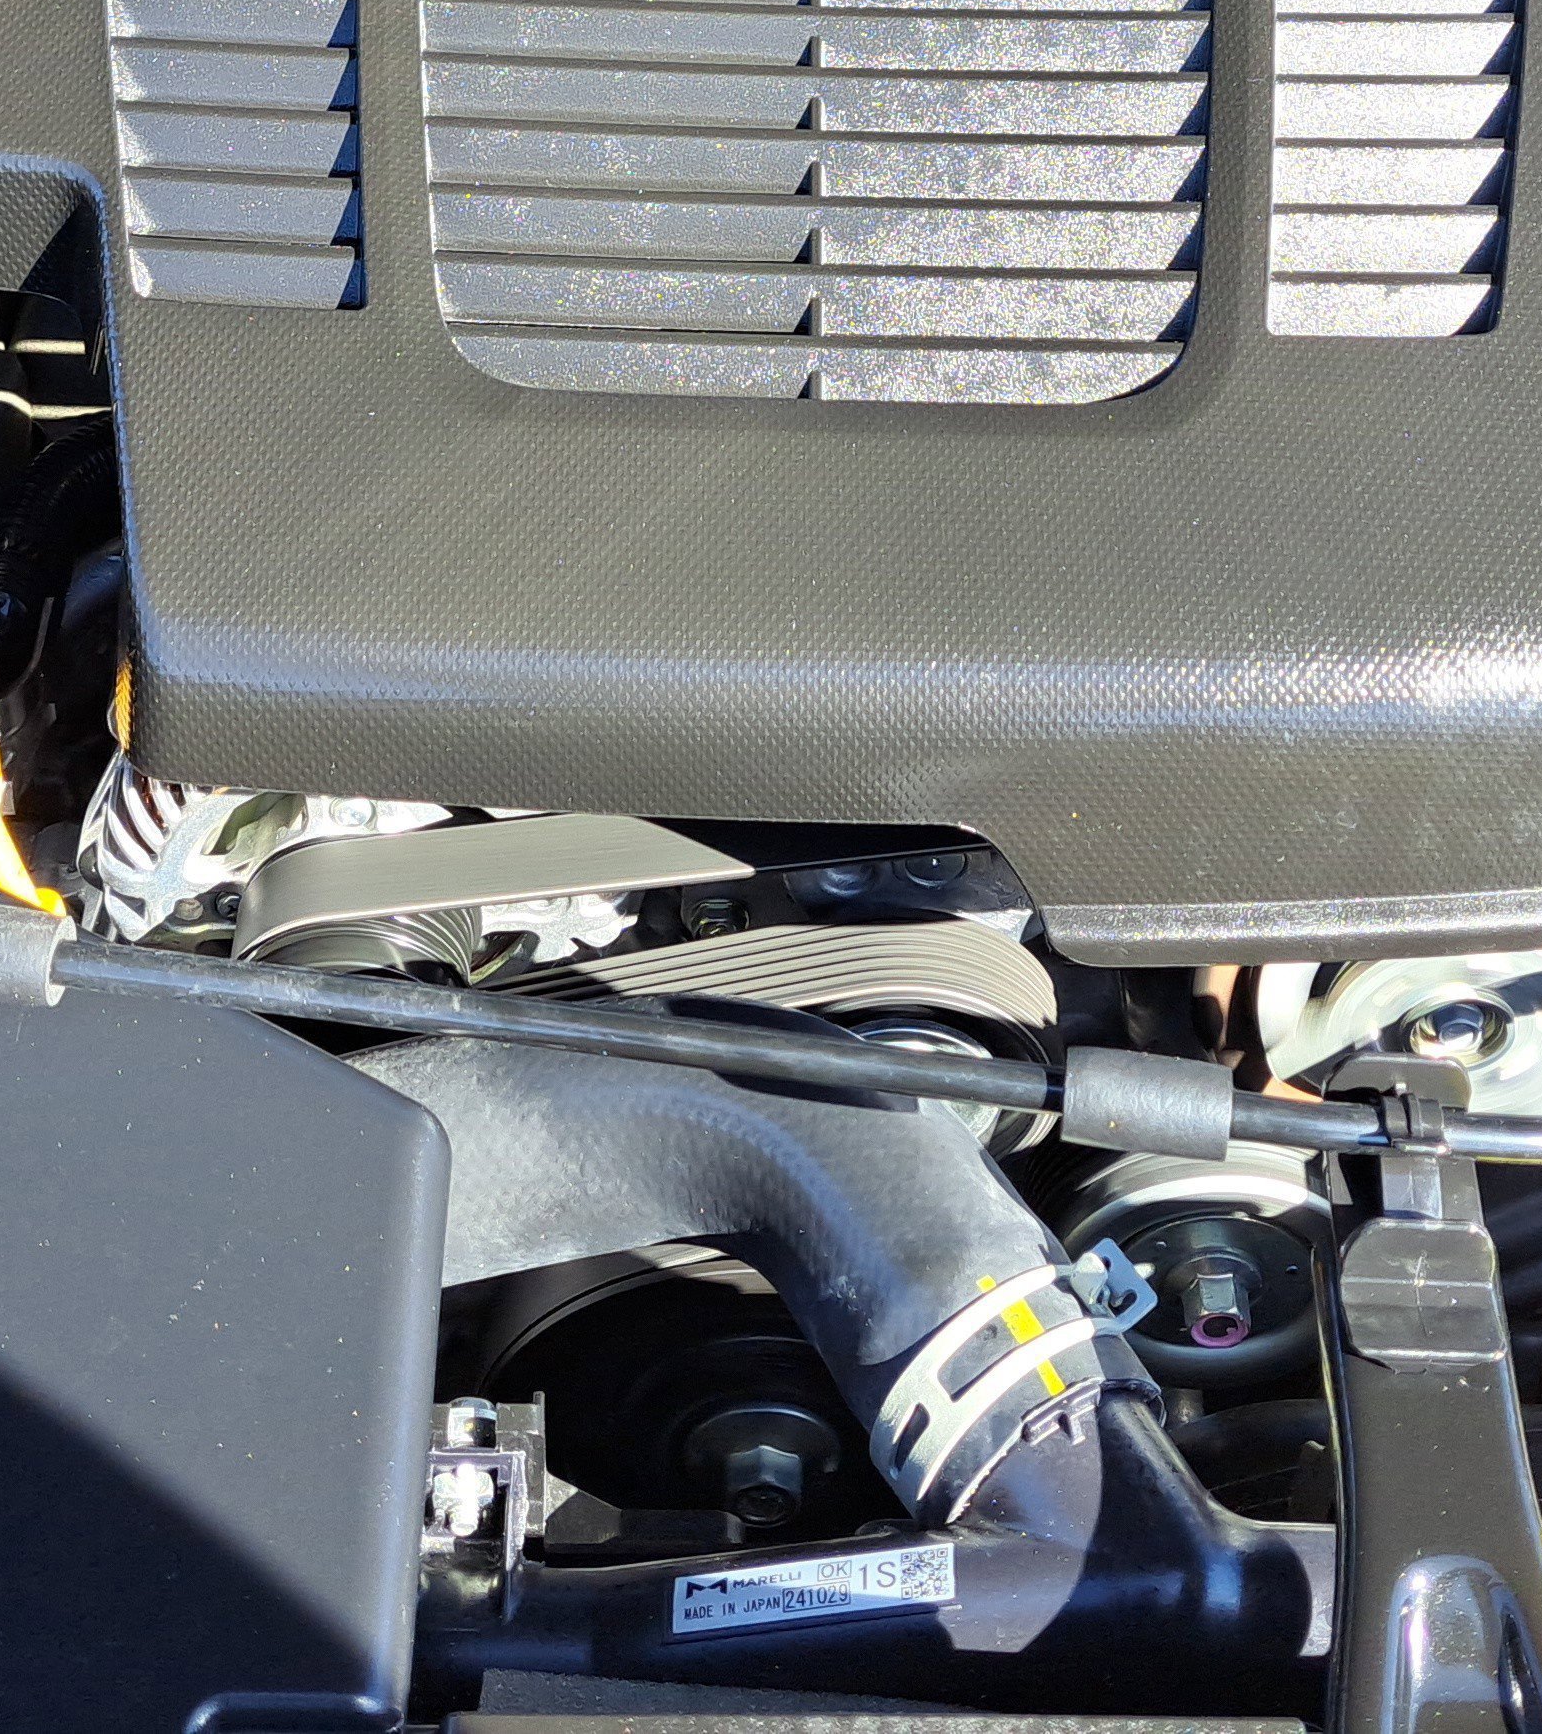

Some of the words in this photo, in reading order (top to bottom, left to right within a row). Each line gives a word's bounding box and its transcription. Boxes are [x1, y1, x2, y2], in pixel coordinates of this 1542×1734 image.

[732, 1570, 802, 1589] MARELLI
[820, 1561, 850, 1579] OK
[858, 1560, 897, 1591] 1S
[683, 1604, 714, 1621] MADE
[722, 1602, 736, 1616] IN
[743, 1596, 781, 1613] JAPAN
[785, 1584, 850, 1610] 241029
